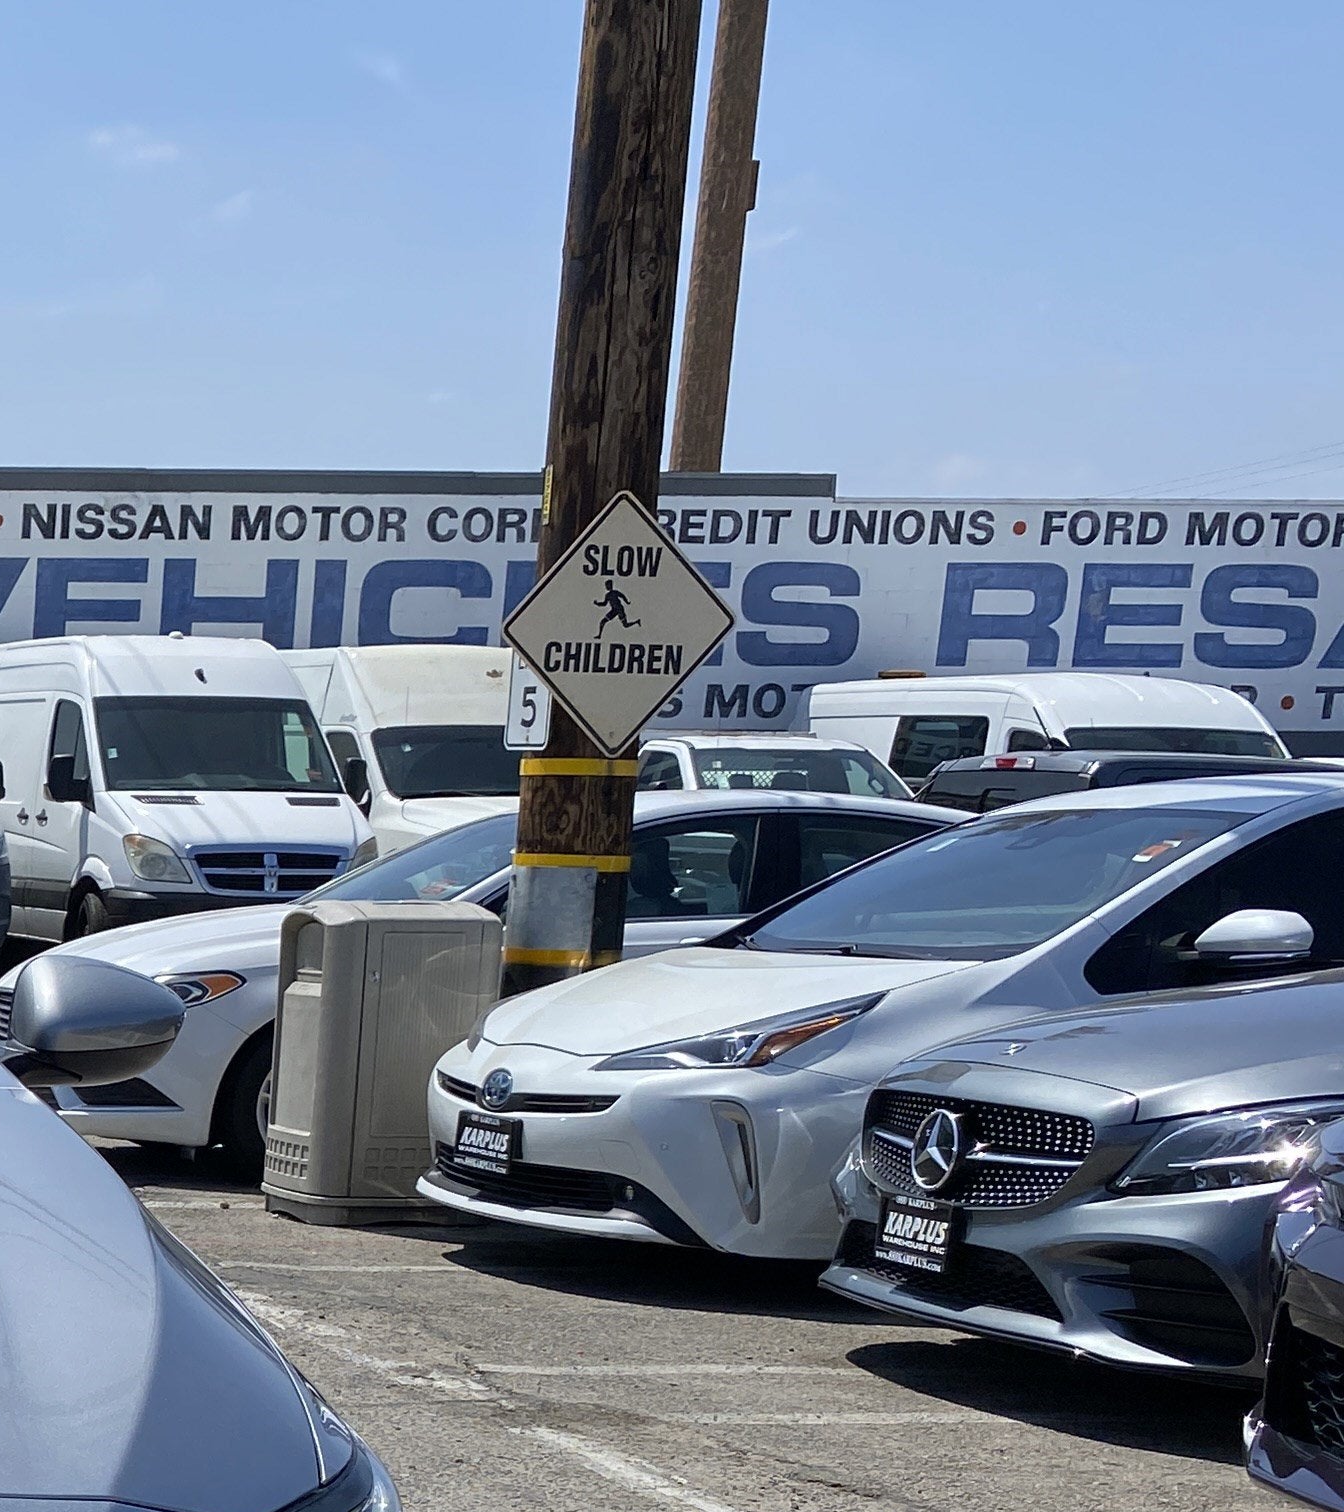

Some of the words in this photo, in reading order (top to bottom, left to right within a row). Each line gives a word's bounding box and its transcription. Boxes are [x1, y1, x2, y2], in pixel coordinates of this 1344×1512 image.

[20, 502, 212, 541] NISSAN
[230, 504, 407, 543] MOTOR
[657, 508, 792, 545] REDIT
[808, 509, 995, 546] UNIONS
[1040, 510, 1169, 546] FORD
[583, 545, 662, 578] SLOW
[544, 641, 683, 675] CHILDREN
[520, 686, 537, 728] 5
[459, 1126, 510, 1152] KARPLUS
[882, 1234, 929, 1252] WAREHOUSE
[930, 1245, 946, 1255] INC
[883, 1211, 949, 1245] KARPLUS
